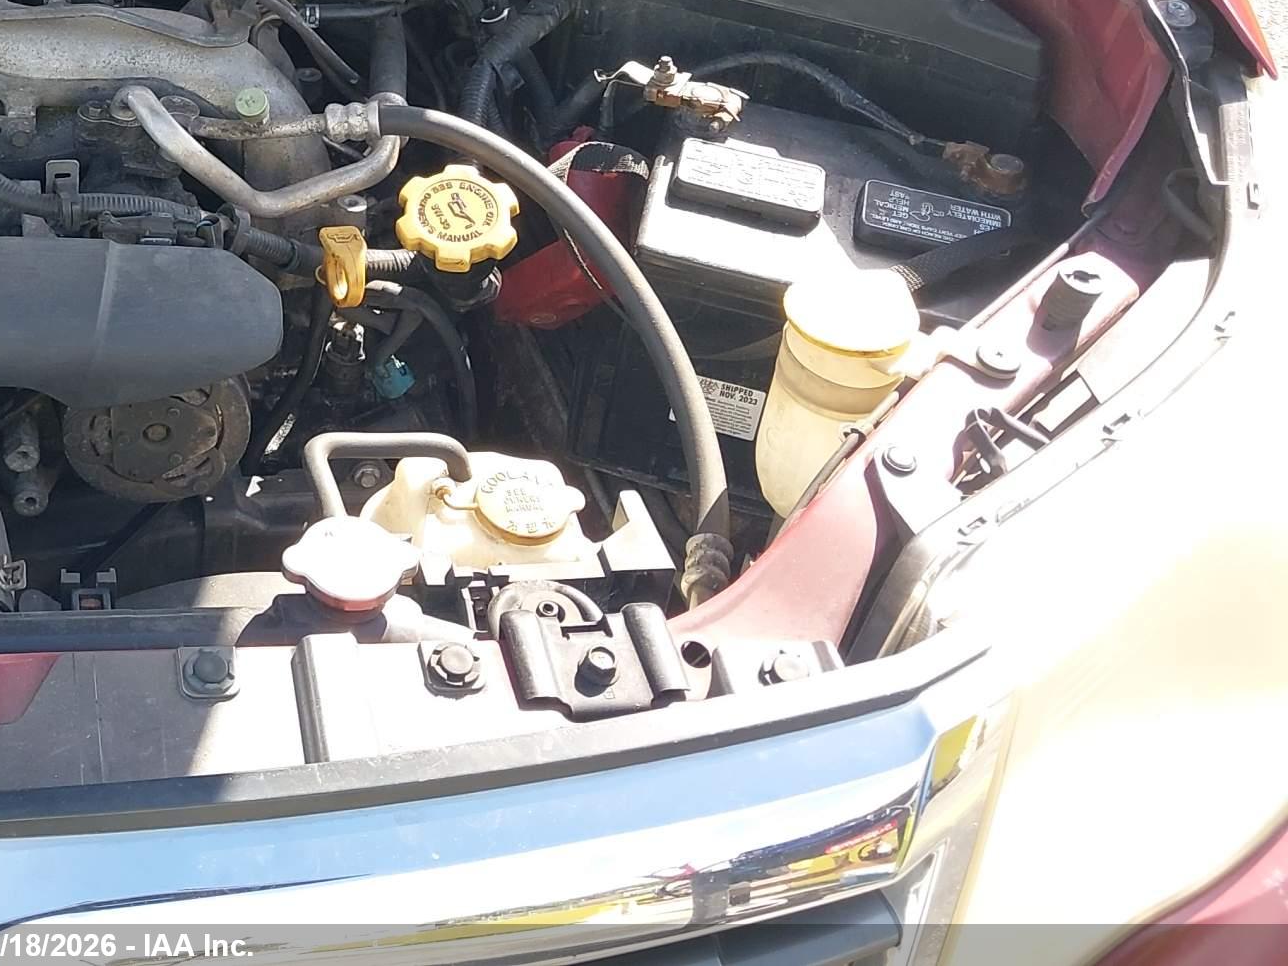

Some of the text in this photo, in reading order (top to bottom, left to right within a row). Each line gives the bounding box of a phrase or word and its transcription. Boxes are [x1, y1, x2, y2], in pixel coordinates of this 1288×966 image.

[873, 198, 910, 212] MEDICAL
[891, 210, 909, 219] GET
[946, 210, 1002, 227] IMMEDIATELY
[950, 204, 1002, 221] WITH WATER
[436, 229, 484, 242] MANUAL
[721, 383, 754, 397] SHIPPED
[719, 390, 759, 406] NOV. 2023
